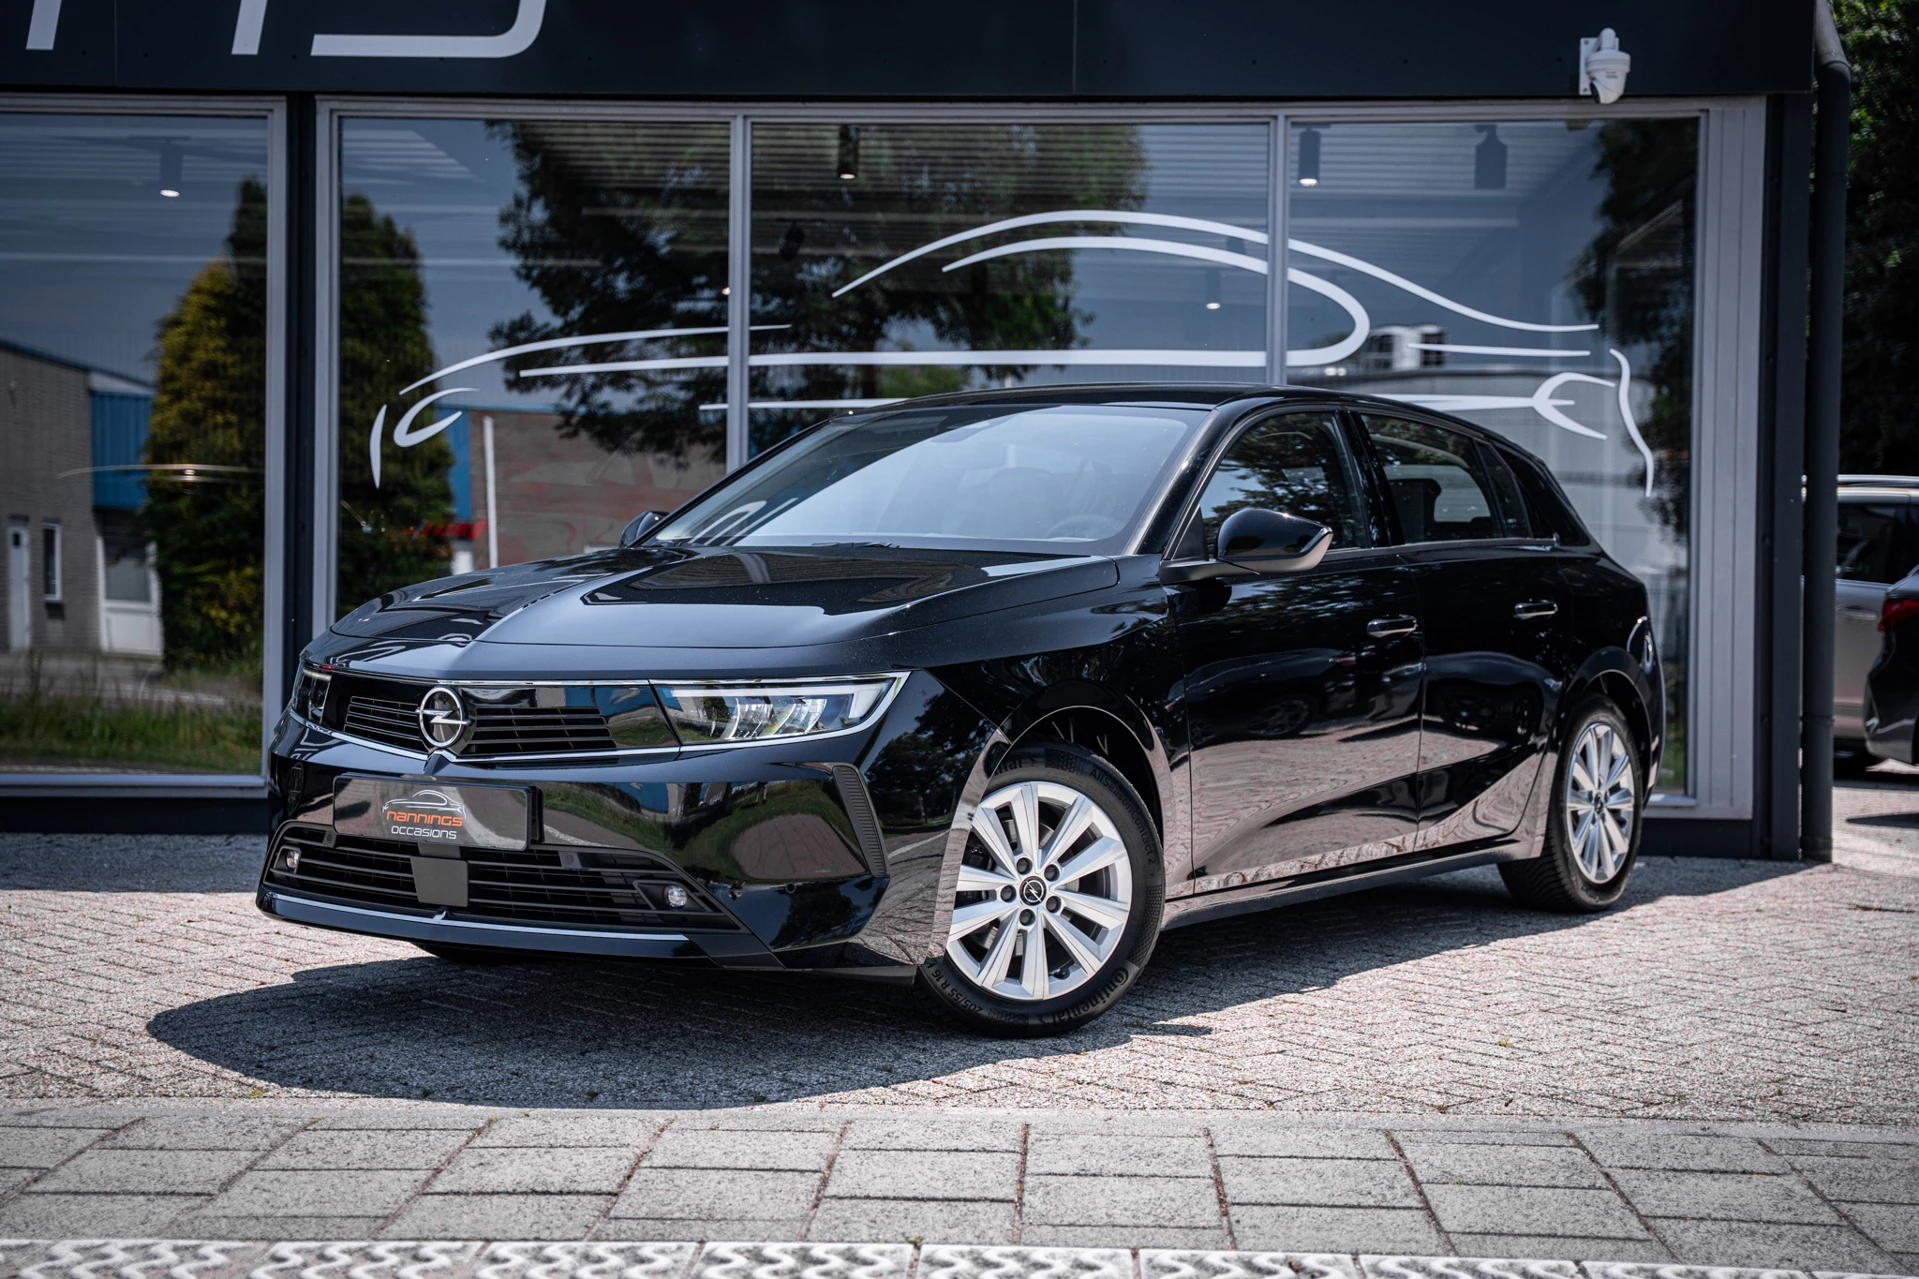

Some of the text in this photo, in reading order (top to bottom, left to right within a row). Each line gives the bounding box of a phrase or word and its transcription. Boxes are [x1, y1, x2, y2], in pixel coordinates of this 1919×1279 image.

[391, 825, 457, 839] occasions
[932, 970, 983, 1012] 205/55 R 16
[1051, 967, 1129, 1025] Continental
